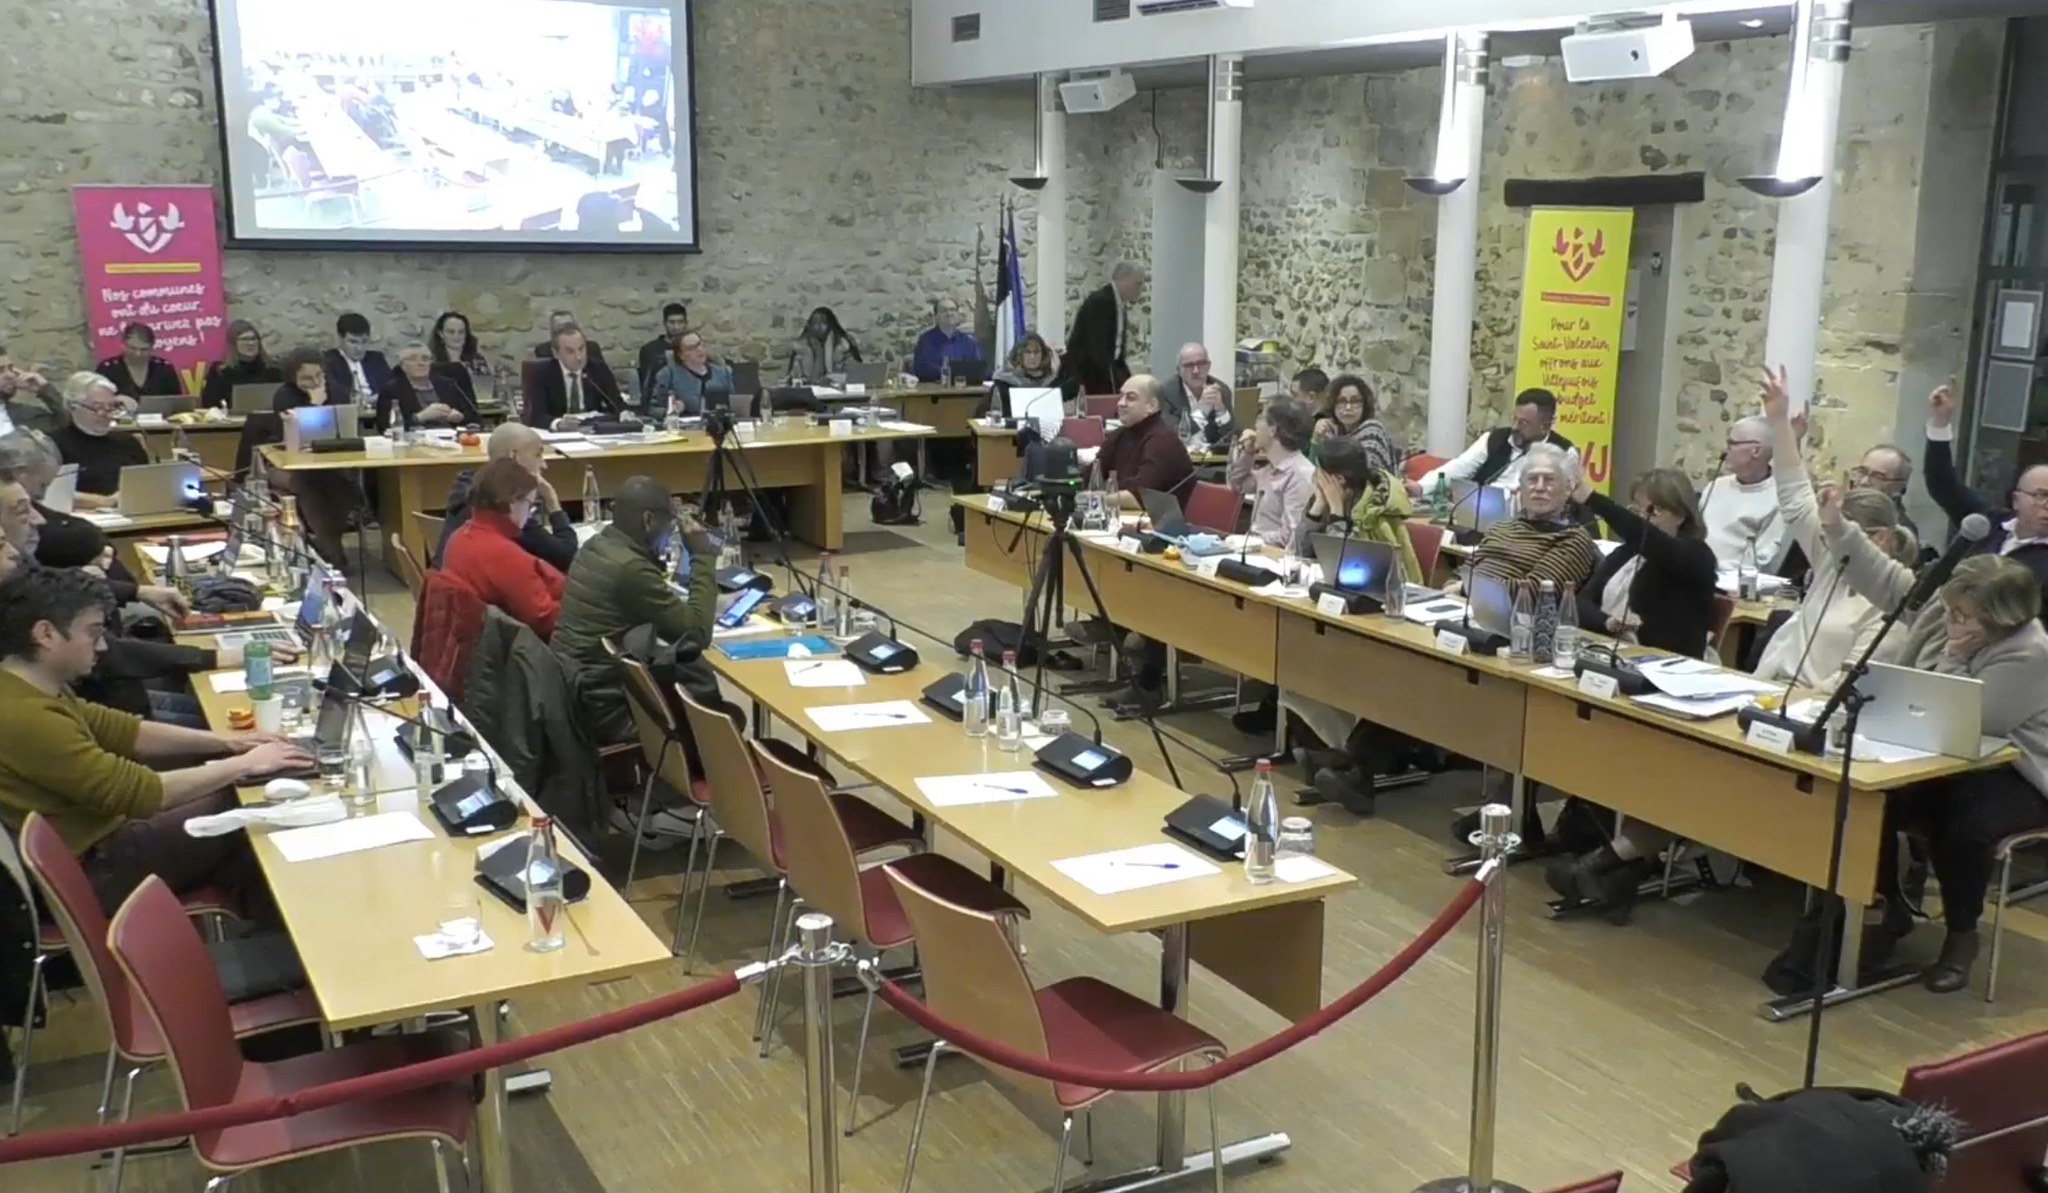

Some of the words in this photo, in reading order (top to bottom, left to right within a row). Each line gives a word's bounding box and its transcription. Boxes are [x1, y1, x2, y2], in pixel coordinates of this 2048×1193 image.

[102, 288, 129, 302] Nos
[132, 283, 205, 299] communes
[111, 304, 137, 318] ont
[139, 302, 160, 316] du
[98, 326, 119, 336] ne
[195, 316, 222, 330] pas
[1551, 317, 1575, 331] Pour
[1579, 317, 1590, 331] la
[1539, 357, 1578, 371] offrons
[1580, 358, 1603, 369] aux
